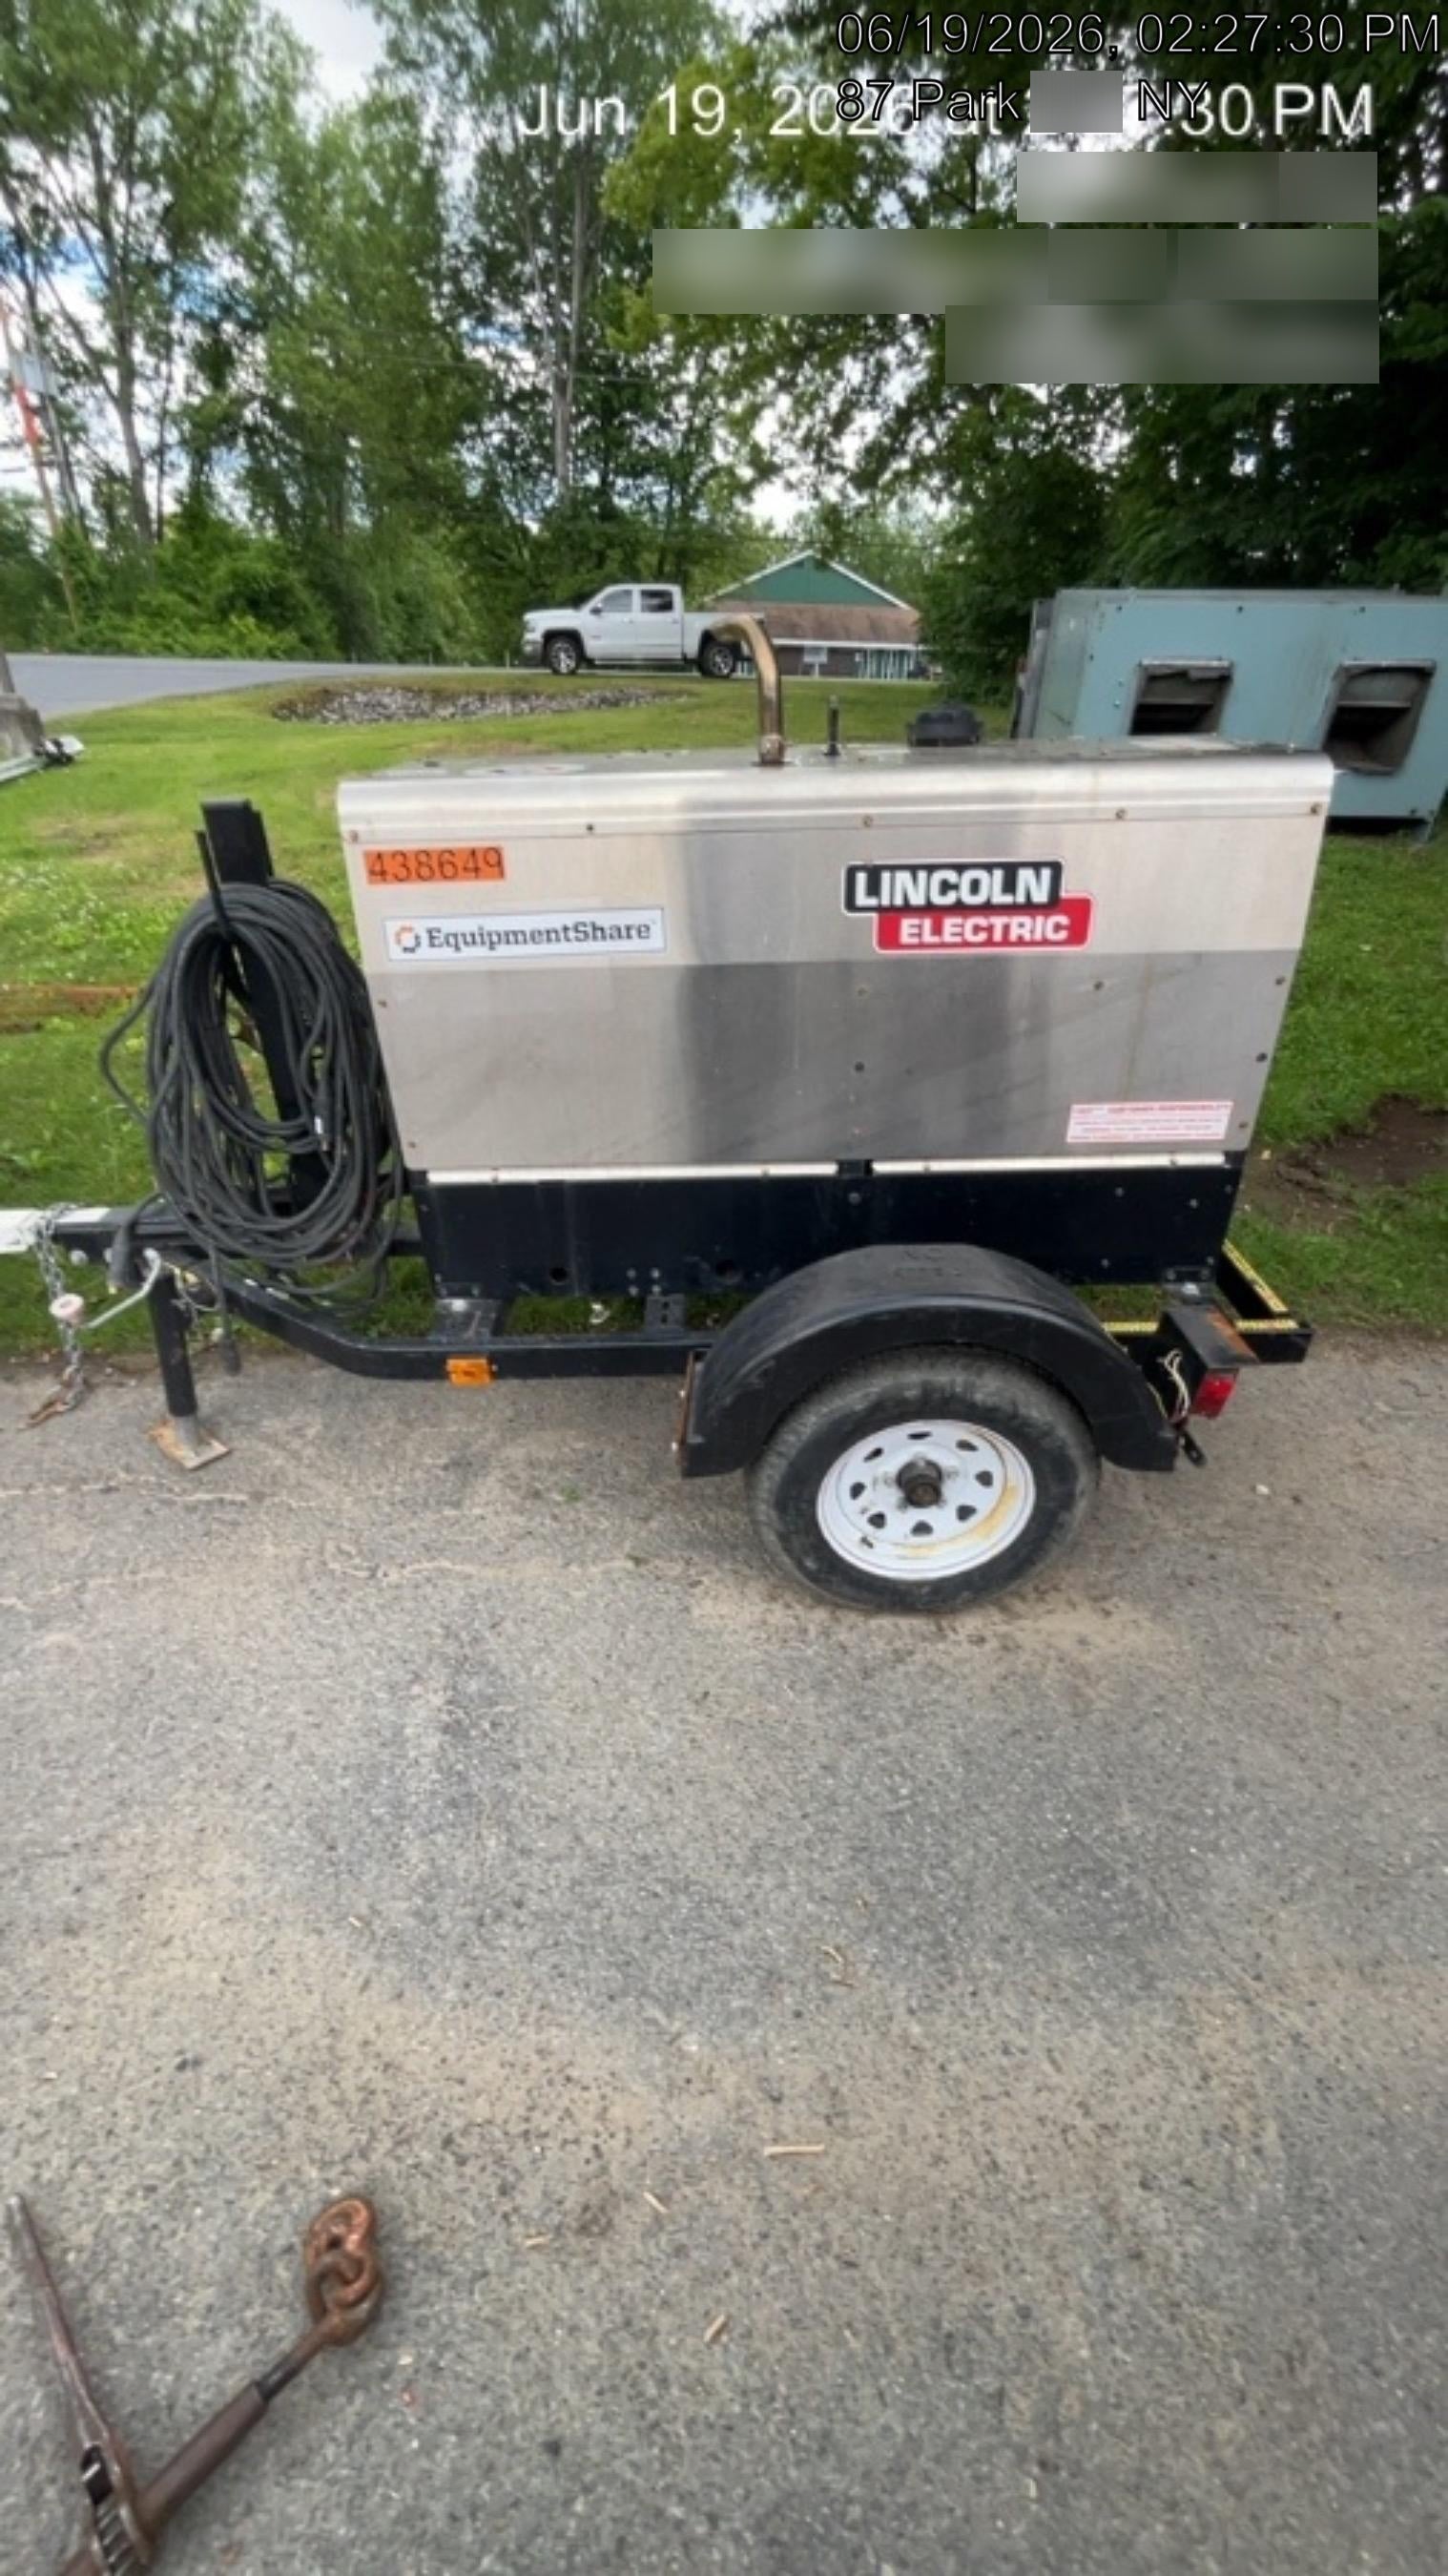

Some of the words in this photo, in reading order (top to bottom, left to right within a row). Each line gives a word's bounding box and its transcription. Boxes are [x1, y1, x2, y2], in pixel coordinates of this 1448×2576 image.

[367, 846, 506, 883] 438649
[854, 866, 1052, 908] LINCOLN
[426, 921, 651, 952] EquipmentShare
[899, 915, 1070, 945] ELECTRIC
